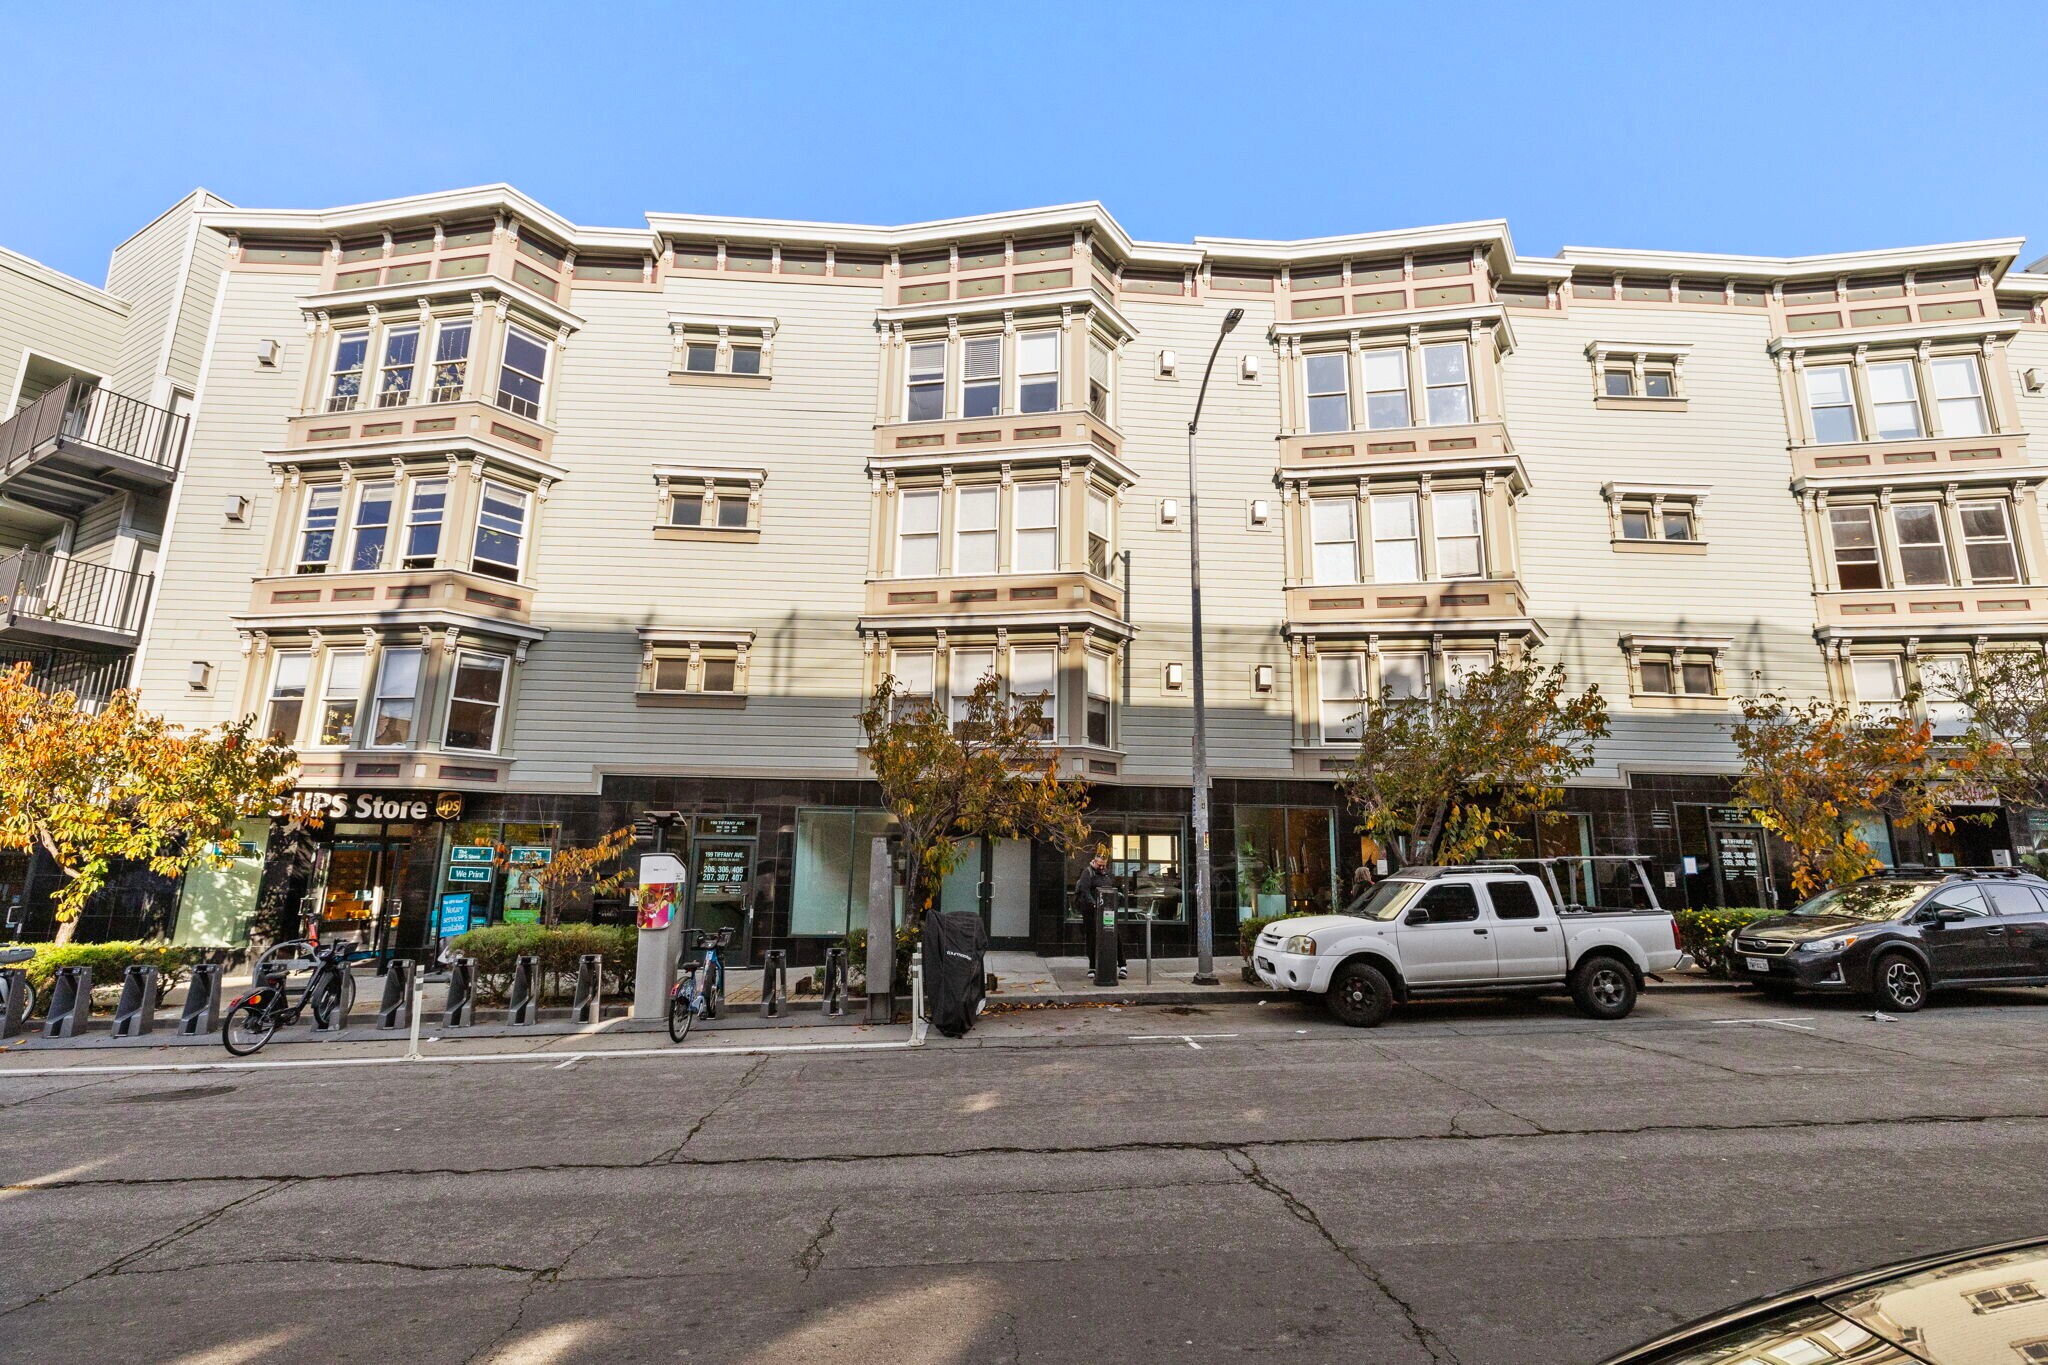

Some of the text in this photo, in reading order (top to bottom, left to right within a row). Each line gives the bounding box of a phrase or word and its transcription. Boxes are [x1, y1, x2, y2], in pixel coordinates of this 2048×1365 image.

[292, 791, 348, 818] UPS
[354, 793, 428, 819] Store
[438, 799, 460, 816] ups
[455, 869, 484, 878] We Print
[702, 873, 716, 881] 207,
[716, 873, 730, 882] 307,
[445, 906, 463, 915] Notary
[442, 915, 465, 924] services
[440, 924, 465, 933] available
